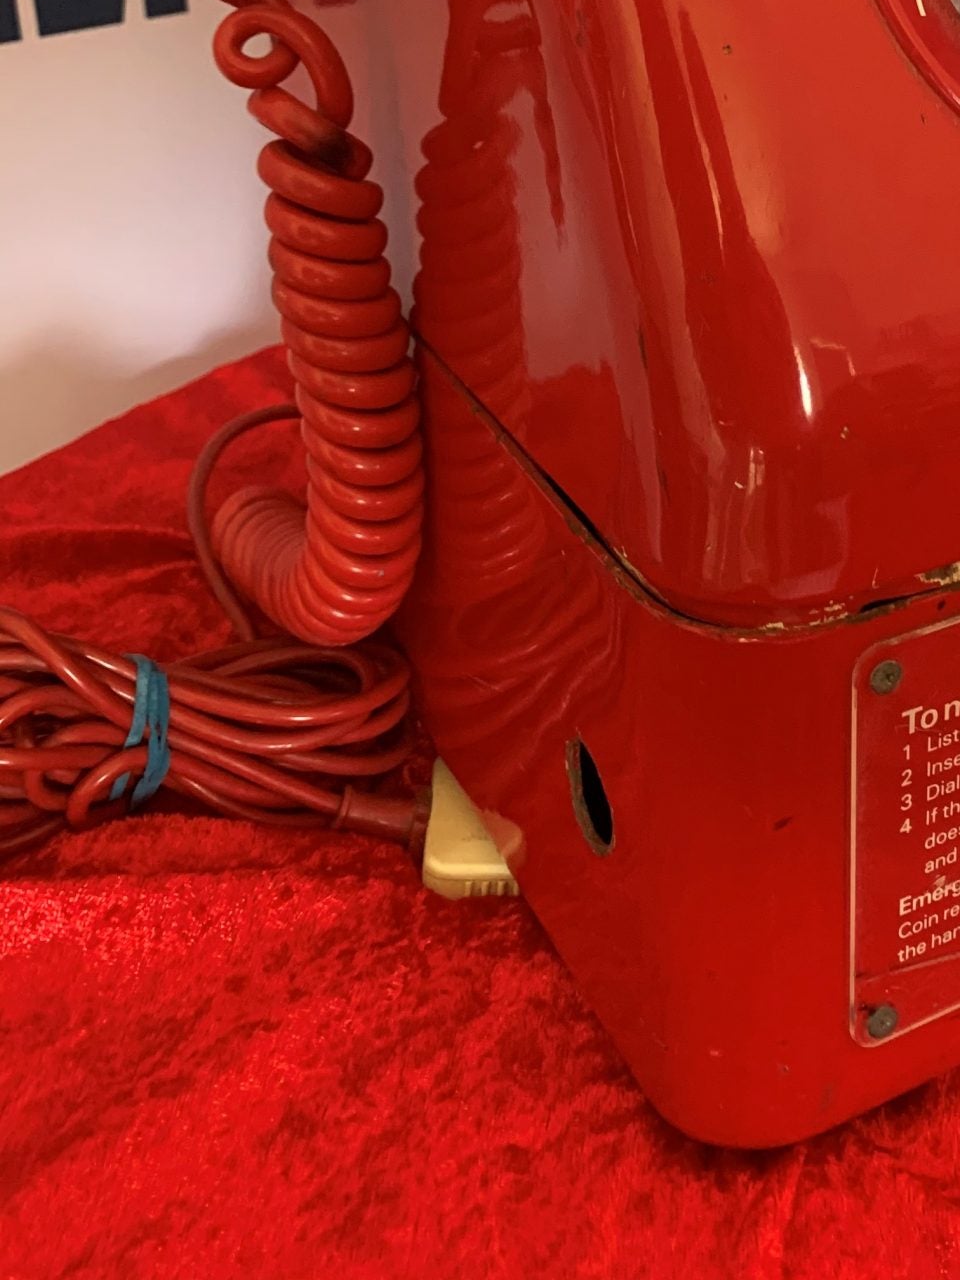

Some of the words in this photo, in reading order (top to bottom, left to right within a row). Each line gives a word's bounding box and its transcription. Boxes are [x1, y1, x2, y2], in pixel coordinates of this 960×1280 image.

[902, 706, 939, 735] To
[902, 744, 911, 760] 1
[901, 768, 912, 787] 2
[901, 793, 912, 811] 3
[926, 774, 960, 801] Dial
[900, 818, 912, 834] 4
[925, 808, 938, 825] If
[924, 847, 957, 873] and
[898, 914, 939, 939] Coin
[897, 941, 926, 962] the
